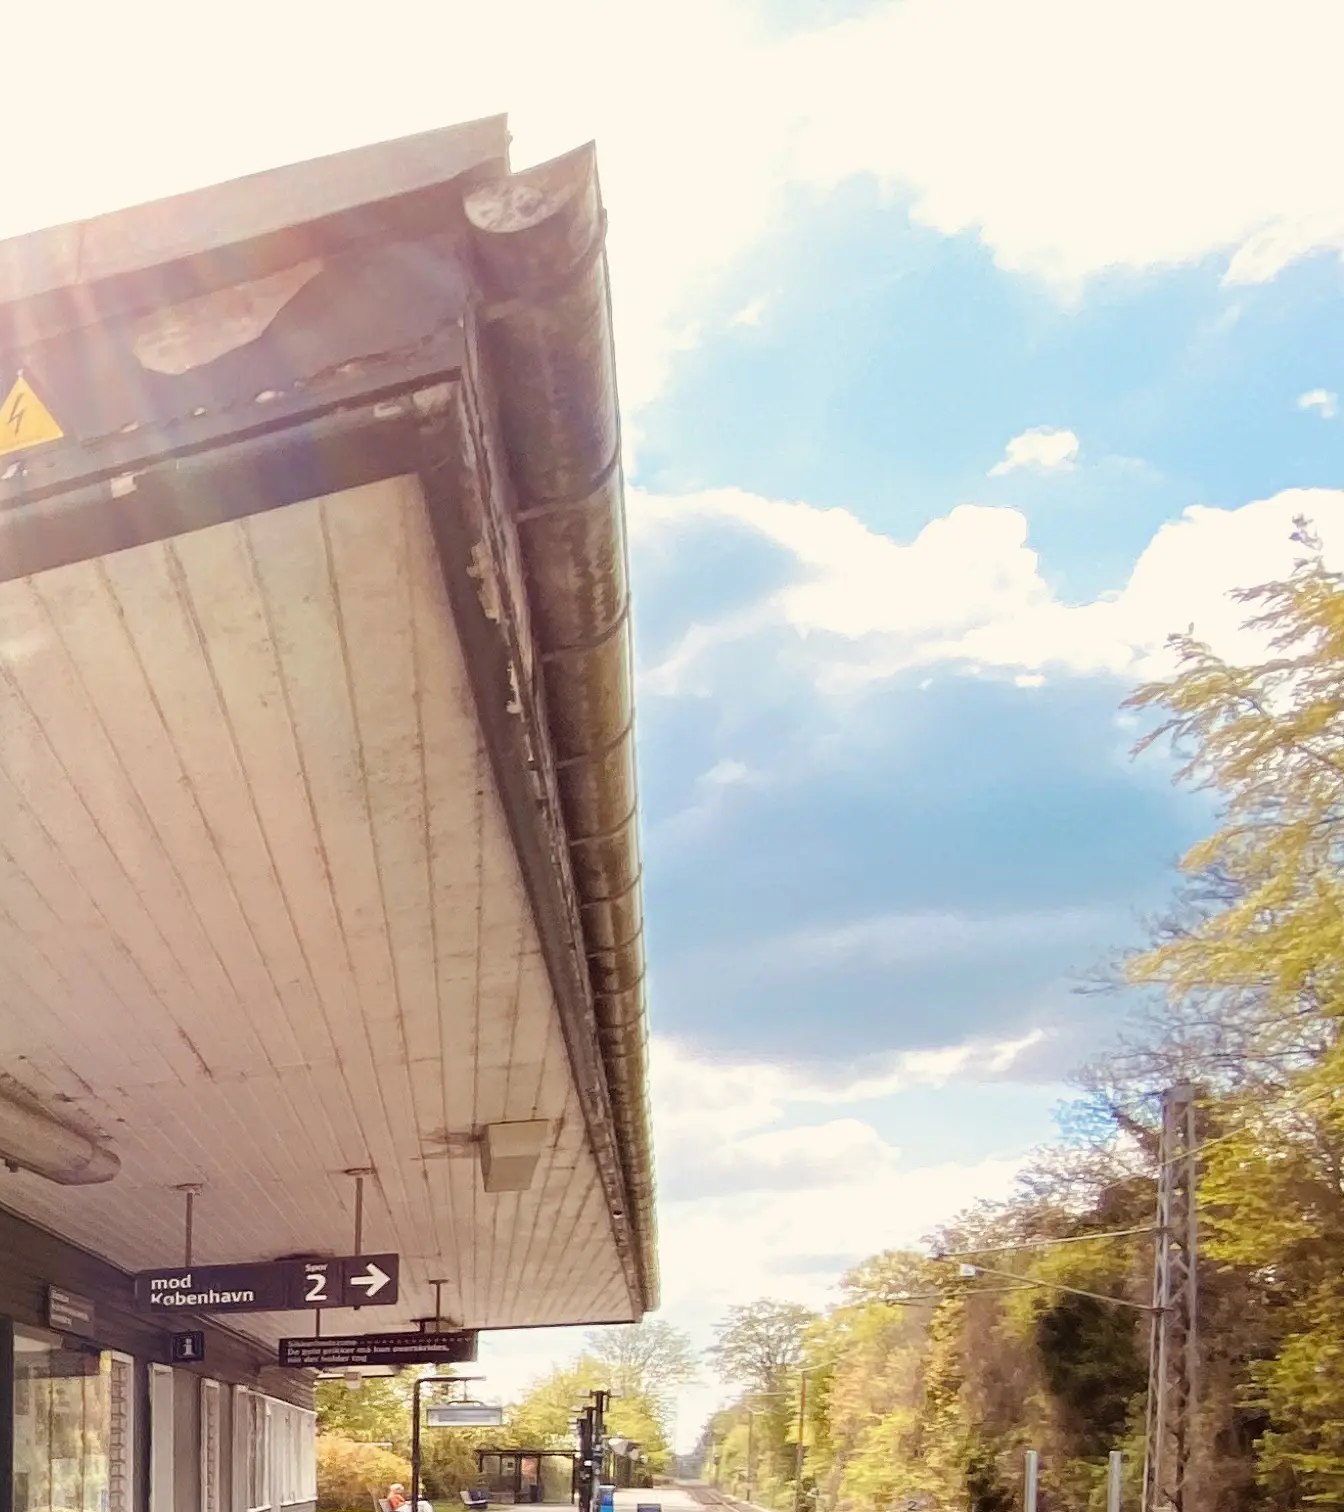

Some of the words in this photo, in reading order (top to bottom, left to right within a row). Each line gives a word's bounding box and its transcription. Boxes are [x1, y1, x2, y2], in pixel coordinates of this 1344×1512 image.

[151, 1274, 192, 1290] mod
[304, 1274, 328, 1302] 2
[151, 1289, 254, 1306] København
